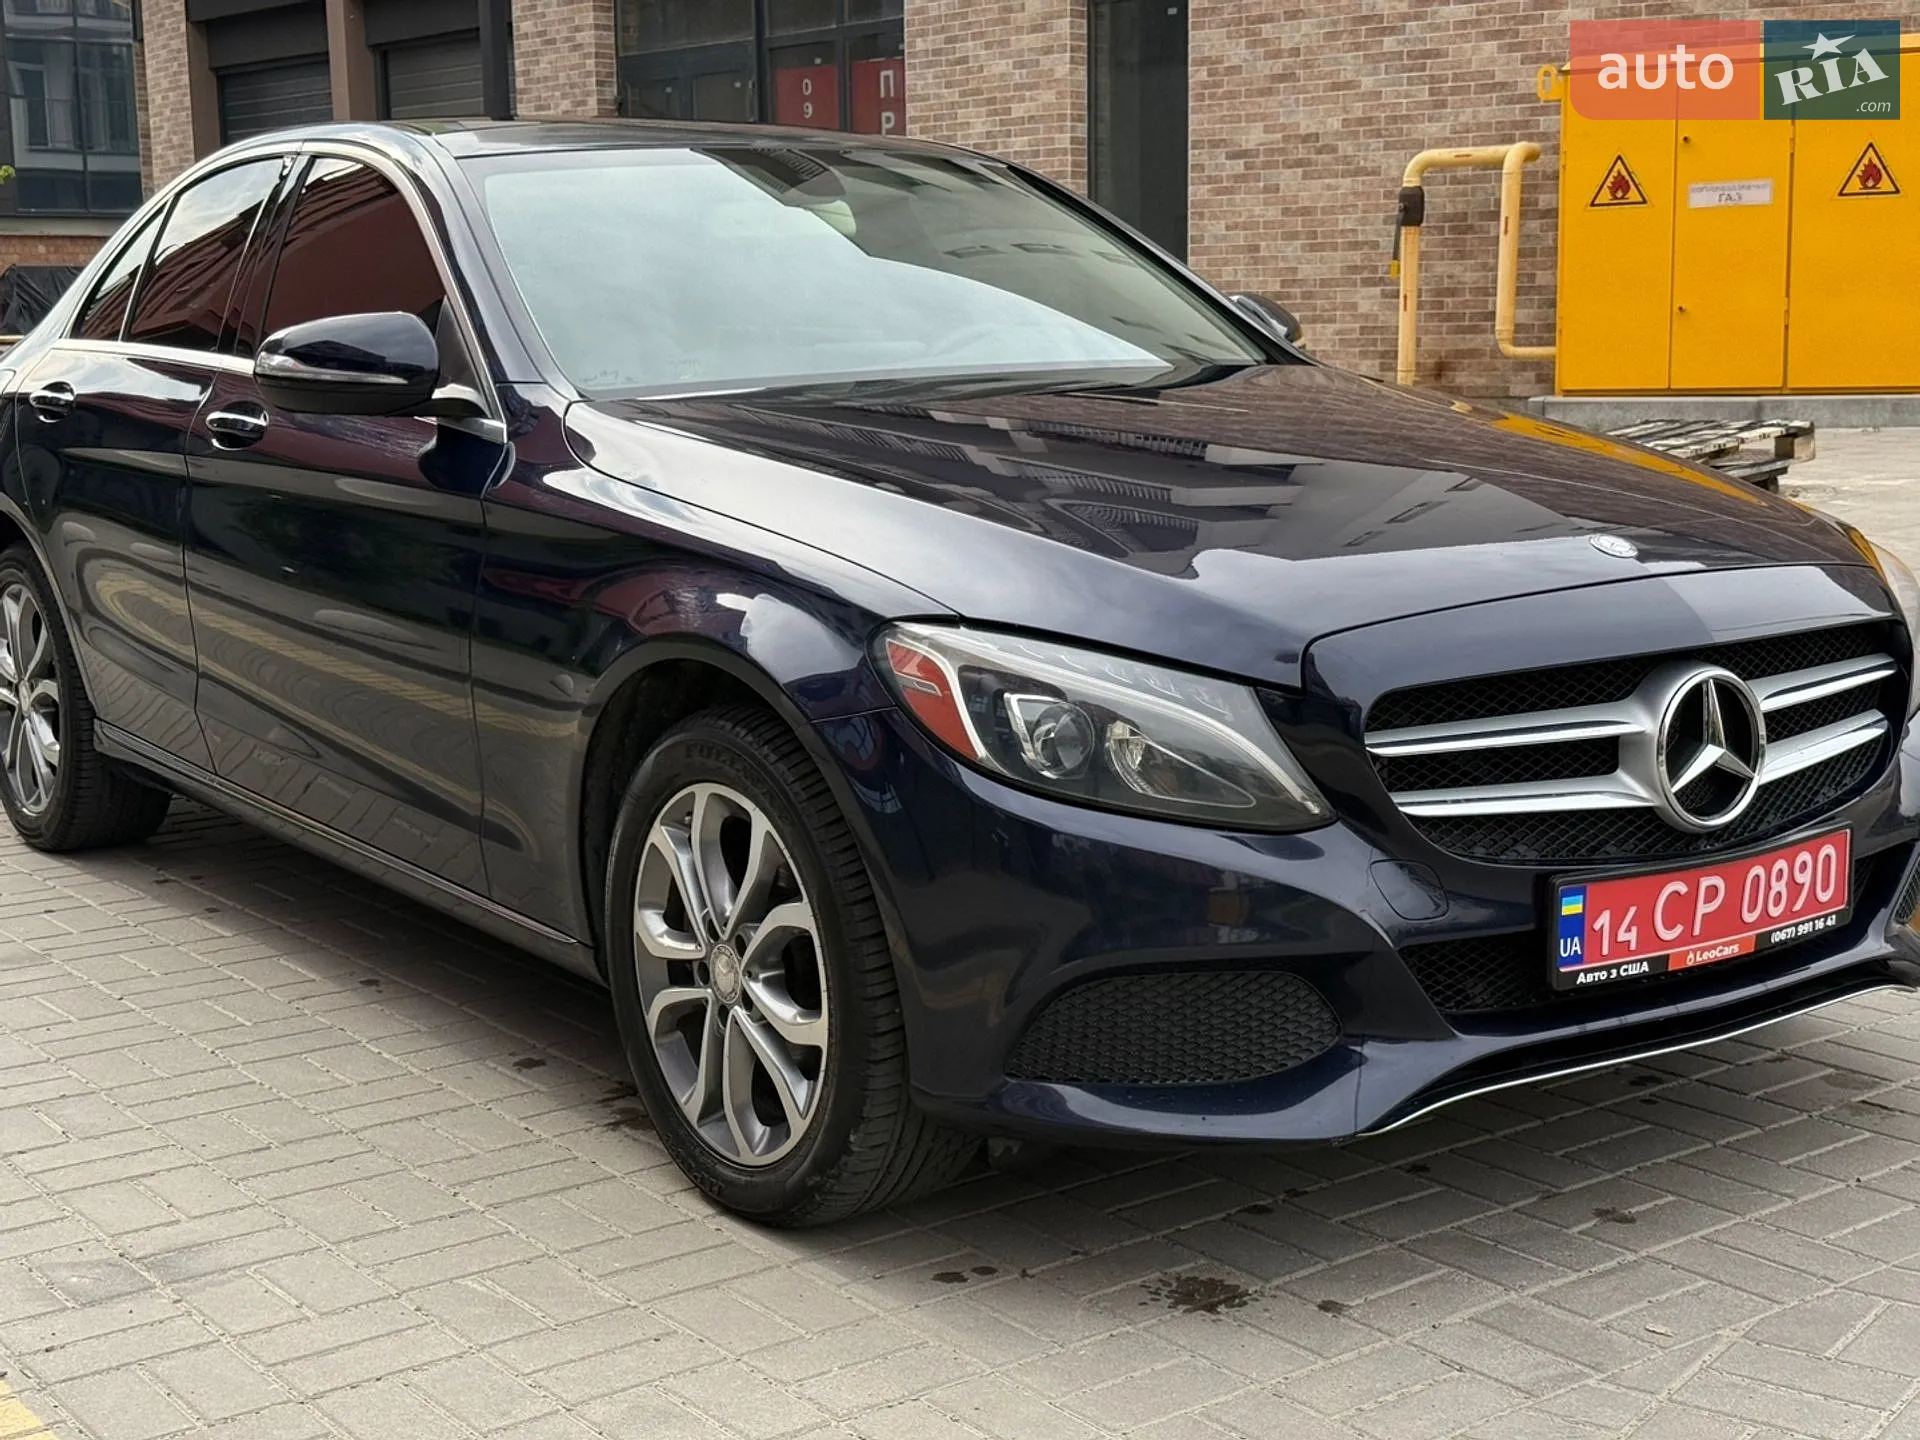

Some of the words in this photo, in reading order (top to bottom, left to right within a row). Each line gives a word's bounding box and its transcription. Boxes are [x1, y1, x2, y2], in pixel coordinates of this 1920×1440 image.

[1718, 192, 1742, 203] ГАЗ
[1592, 905, 1638, 956] 14
[1740, 843, 1838, 924] 0890
[1770, 926, 1796, 944] (067)
[1797, 921, 1814, 936] 991
[1560, 937, 1582, 958] UA
[1696, 943, 1740, 962] LeoCars
[1619, 961, 1649, 977] США
